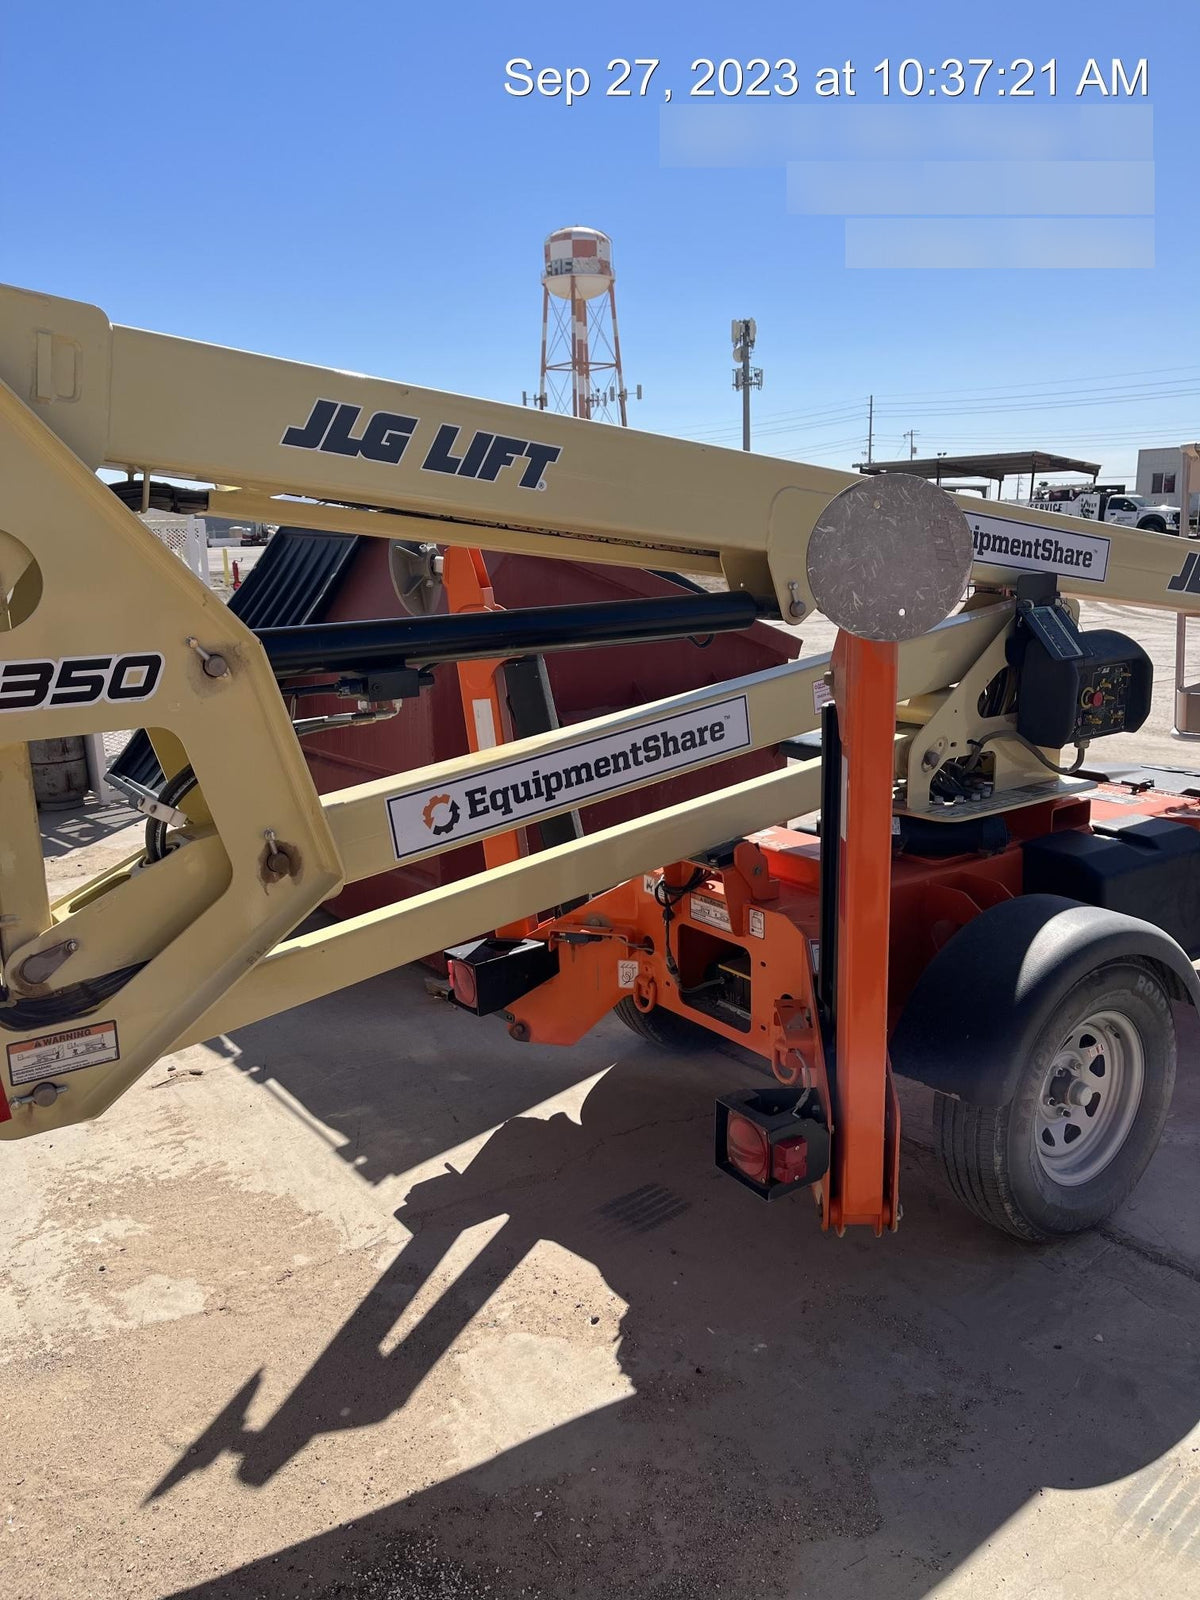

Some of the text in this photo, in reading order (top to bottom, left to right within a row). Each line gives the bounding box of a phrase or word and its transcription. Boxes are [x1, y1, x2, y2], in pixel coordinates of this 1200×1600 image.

[280, 398, 563, 489] JLG LIFT
[970, 525, 1093, 568] ipmentShare
[0, 652, 165, 712] 350
[465, 720, 725, 820] EquipmentShare
[43, 1029, 91, 1046] WARNING
